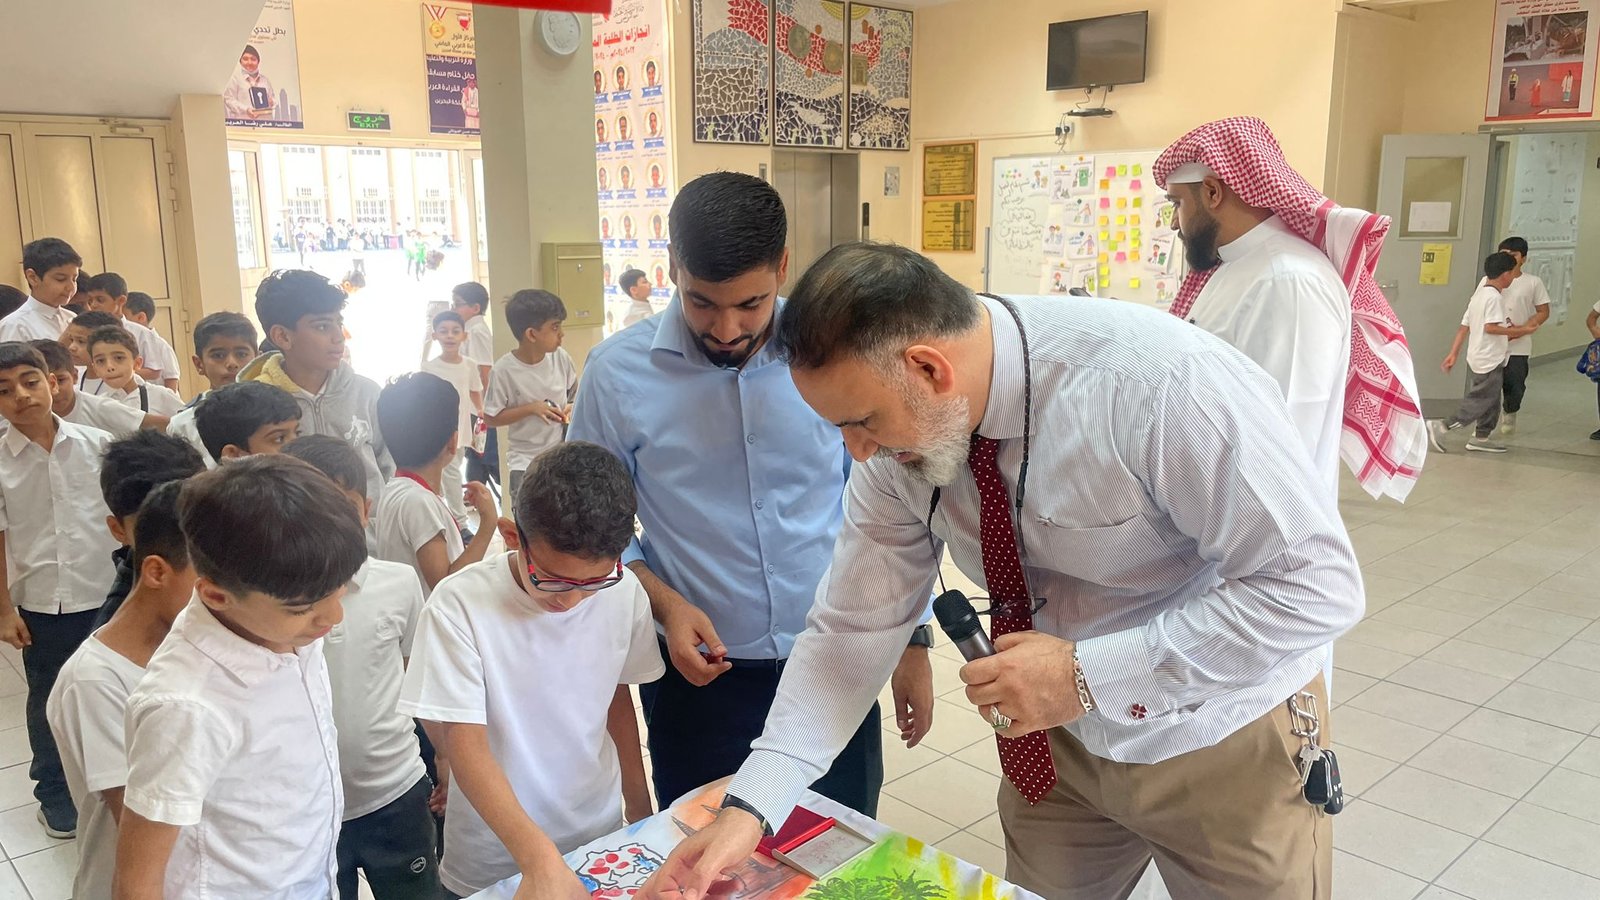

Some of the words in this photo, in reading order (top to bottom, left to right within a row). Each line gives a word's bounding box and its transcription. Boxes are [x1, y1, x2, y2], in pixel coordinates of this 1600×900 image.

[447, 70, 461, 78] ختام
[462, 71, 475, 80] حفل
[428, 83, 441, 91] العرب
[353, 115, 385, 124] خروج
